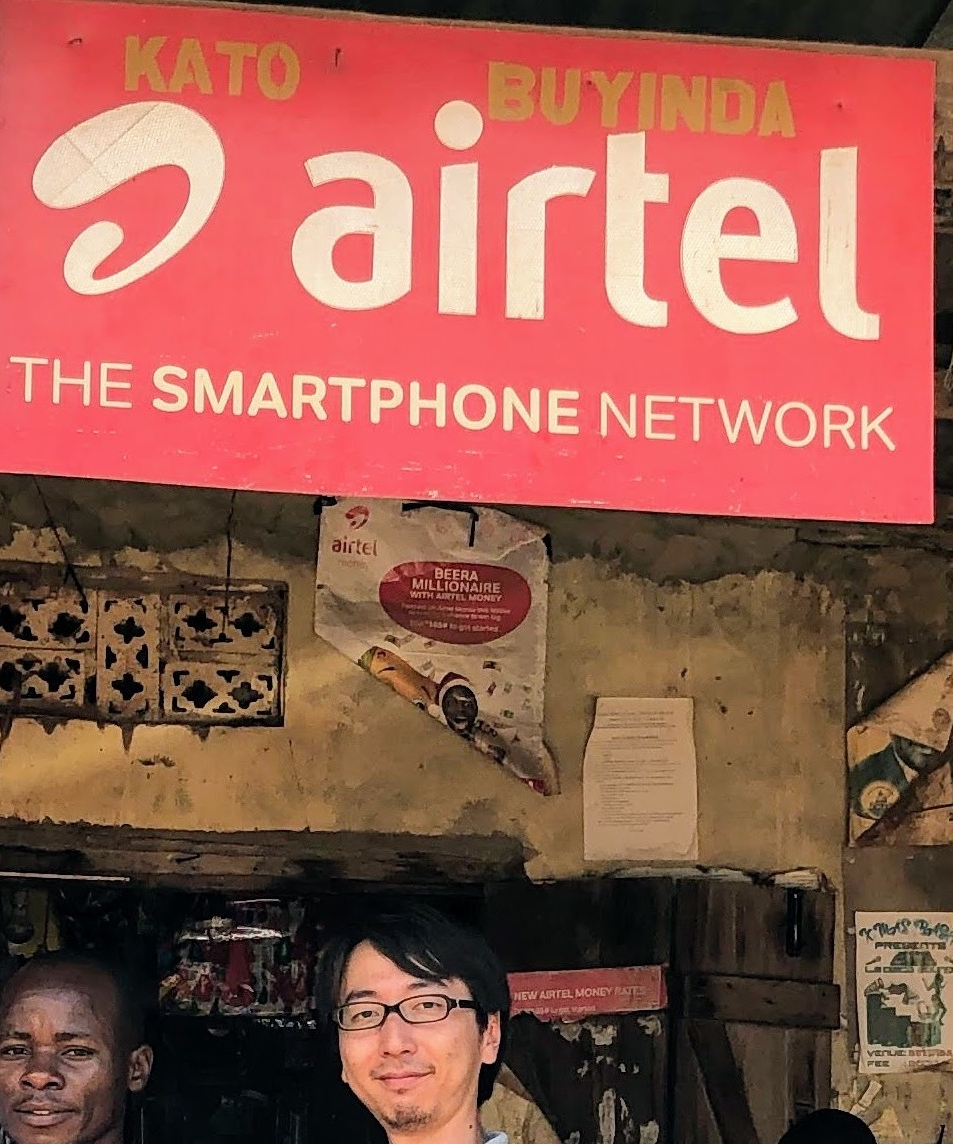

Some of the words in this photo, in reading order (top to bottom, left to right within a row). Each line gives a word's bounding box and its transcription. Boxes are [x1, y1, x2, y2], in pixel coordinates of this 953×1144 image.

[123, 35, 300, 101] KATO
[487, 61, 797, 138] BUYINDA
[290, 99, 881, 341] airtel
[9, 355, 133, 410] THE
[151, 366, 580, 436] SMARTPHONE
[598, 391, 896, 453] NETWORK
[331, 534, 378, 557] airtel
[434, 567, 480, 582] BEERA
[412, 578, 501, 594] MILLIONAIRE
[409, 590, 434, 600] WITH
[435, 592, 467, 602] AIRTEL
[468, 594, 503, 603] MONEY
[513, 991, 538, 1001] NEW
[539, 989, 574, 1000] AIRTEL
[575, 986, 613, 999] MONEY
